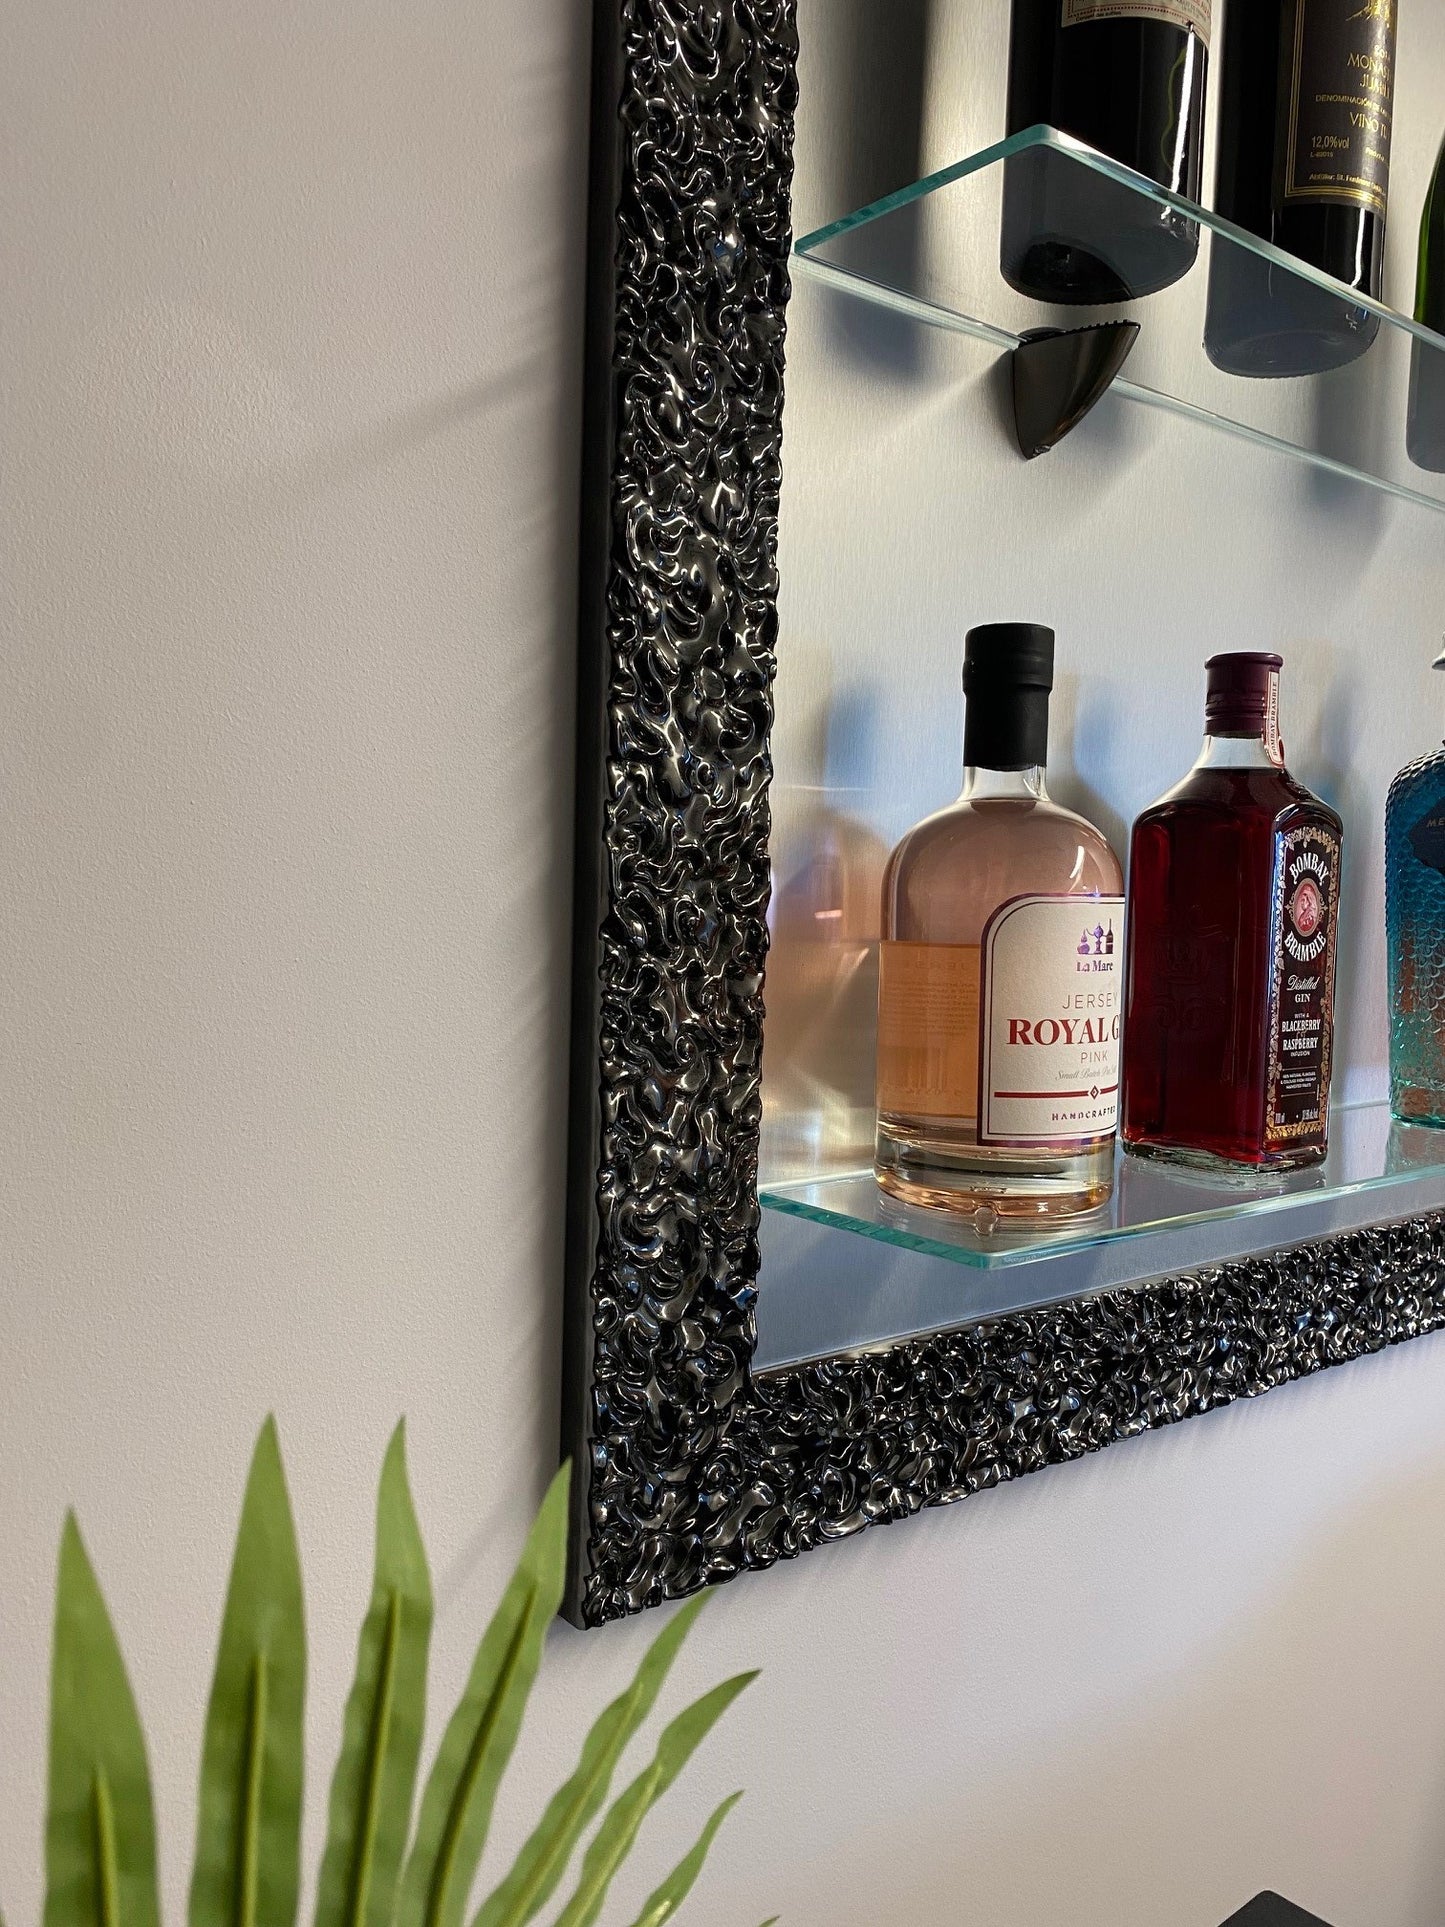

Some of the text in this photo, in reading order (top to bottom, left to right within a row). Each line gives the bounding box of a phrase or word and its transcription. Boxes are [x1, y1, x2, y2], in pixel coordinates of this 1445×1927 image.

[1349, 111, 1379, 132] VINO
[1289, 852, 1329, 886] BOMBAY
[1284, 931, 1327, 962] BRAMBLE
[1076, 962, 1090, 972] La
[1286, 974, 1321, 991] Distilled
[1062, 993, 1118, 1010] JERSEY
[1294, 993, 1311, 1003] GIN
[1006, 1017, 1109, 1046] ROYAL
[1281, 1019, 1321, 1033] BLACKBERRY
[1282, 1037, 1319, 1051] RASPBERRY
[1080, 1050, 1108, 1064] PINK
